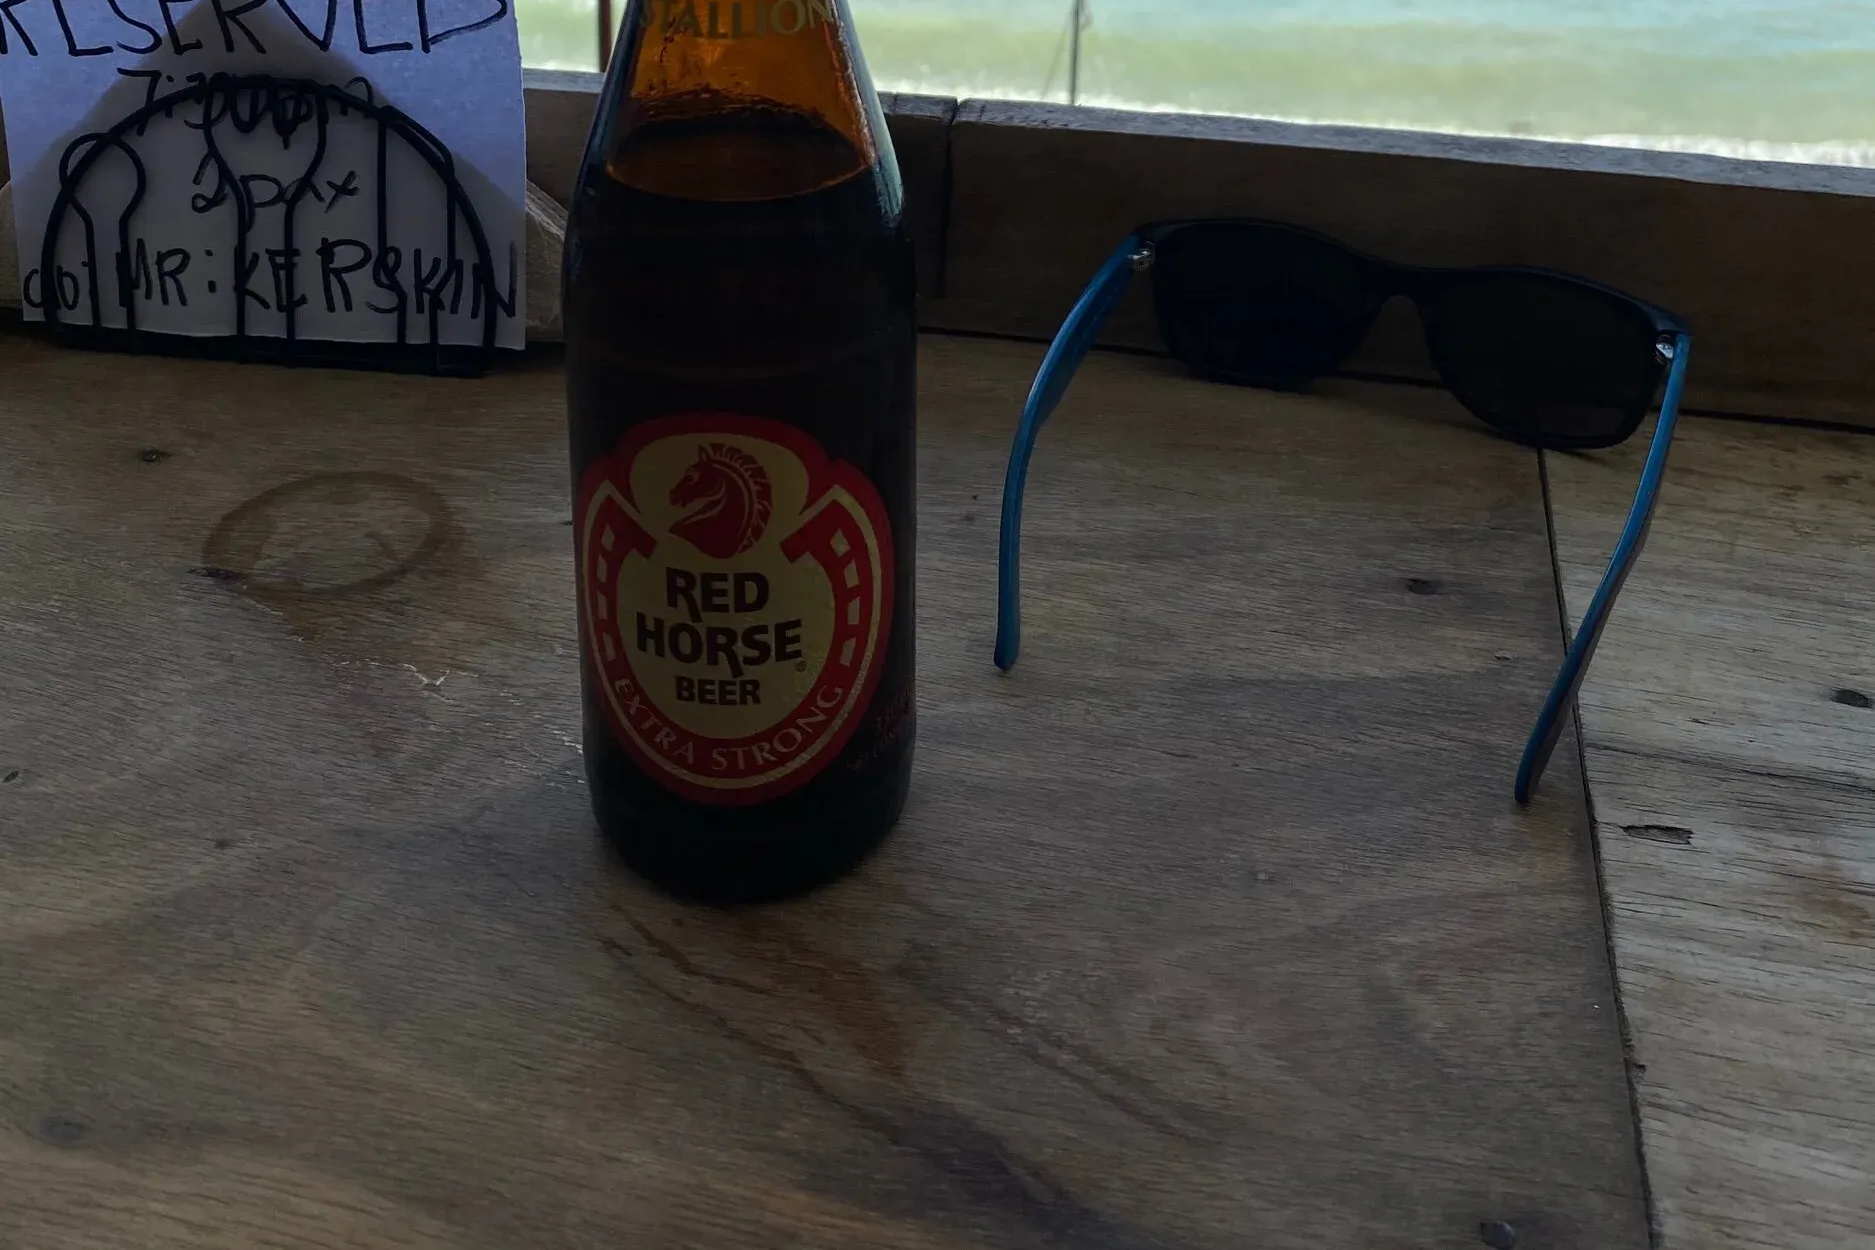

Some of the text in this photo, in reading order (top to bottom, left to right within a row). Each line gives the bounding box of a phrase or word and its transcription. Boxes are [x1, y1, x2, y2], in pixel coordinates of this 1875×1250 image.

[666, 567, 769, 623] RED
[636, 611, 804, 678] HORSE
[675, 675, 761, 706] BEER
[613, 677, 697, 765] EXTRA
[712, 684, 845, 772] STRONG
